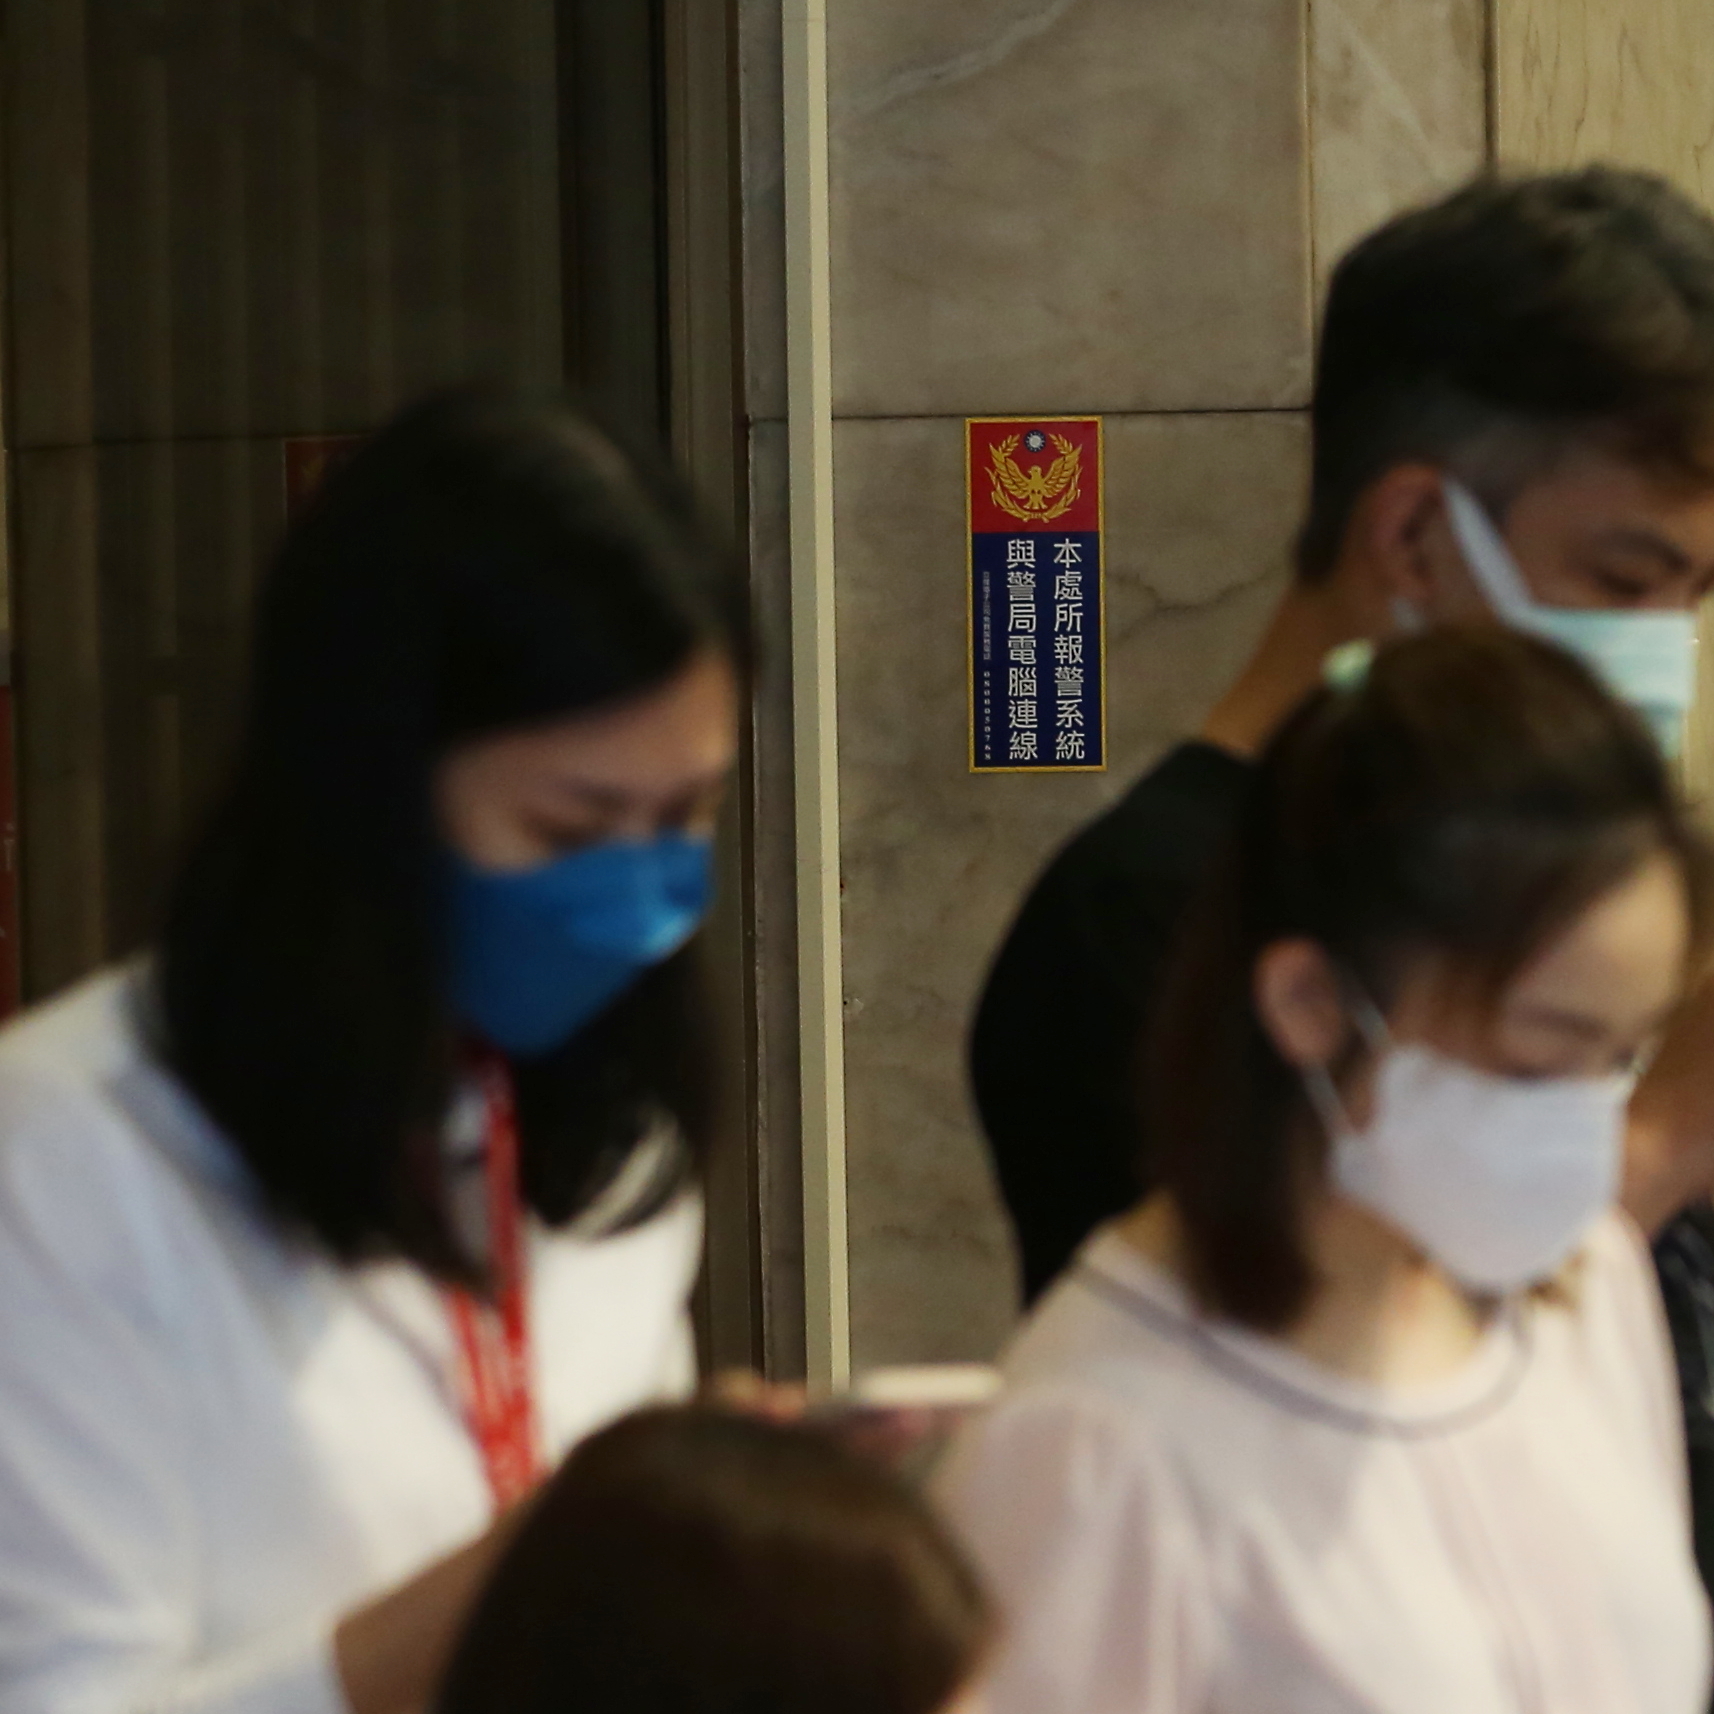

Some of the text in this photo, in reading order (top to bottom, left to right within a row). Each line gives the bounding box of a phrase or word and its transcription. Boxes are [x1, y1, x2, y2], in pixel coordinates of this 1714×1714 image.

[1006, 539, 1038, 761] 與警局電腦連線
[1053, 537, 1085, 761] 本處所報警系統
